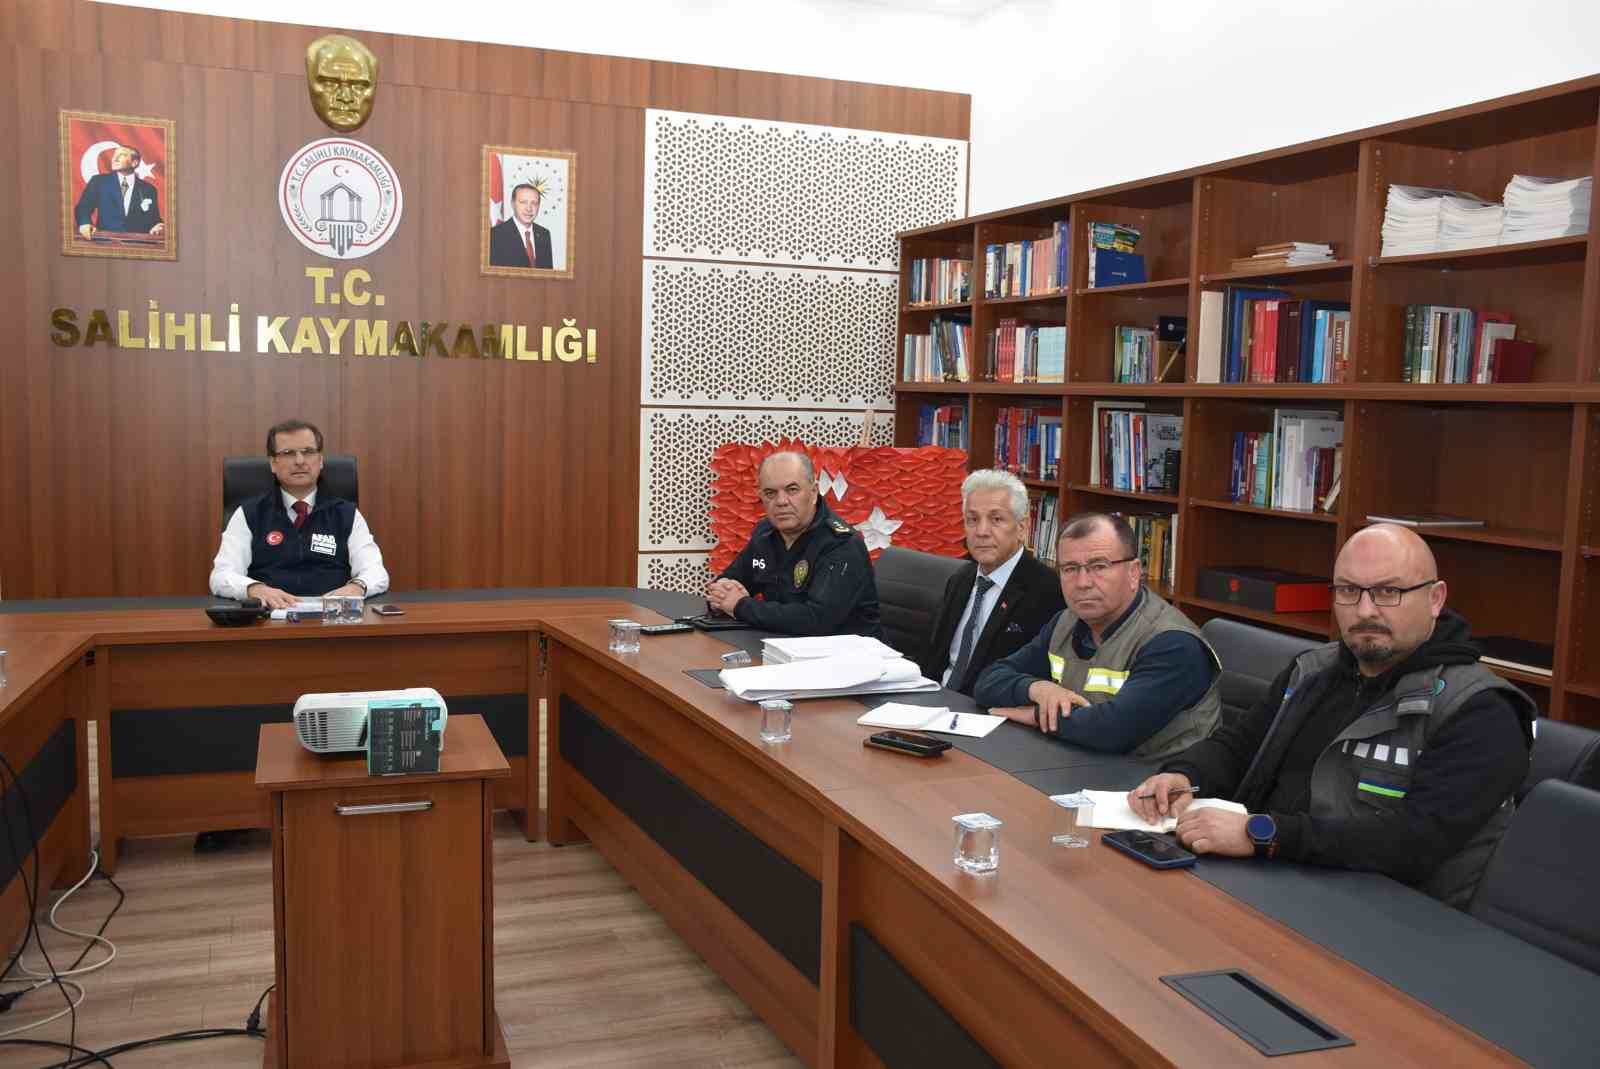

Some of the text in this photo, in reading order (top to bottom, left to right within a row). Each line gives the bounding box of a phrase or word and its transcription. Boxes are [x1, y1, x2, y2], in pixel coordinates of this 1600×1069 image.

[305, 267, 385, 306] T.C.
[51, 300, 597, 363] SALİHLİ KAYMAKAMLIĞI
